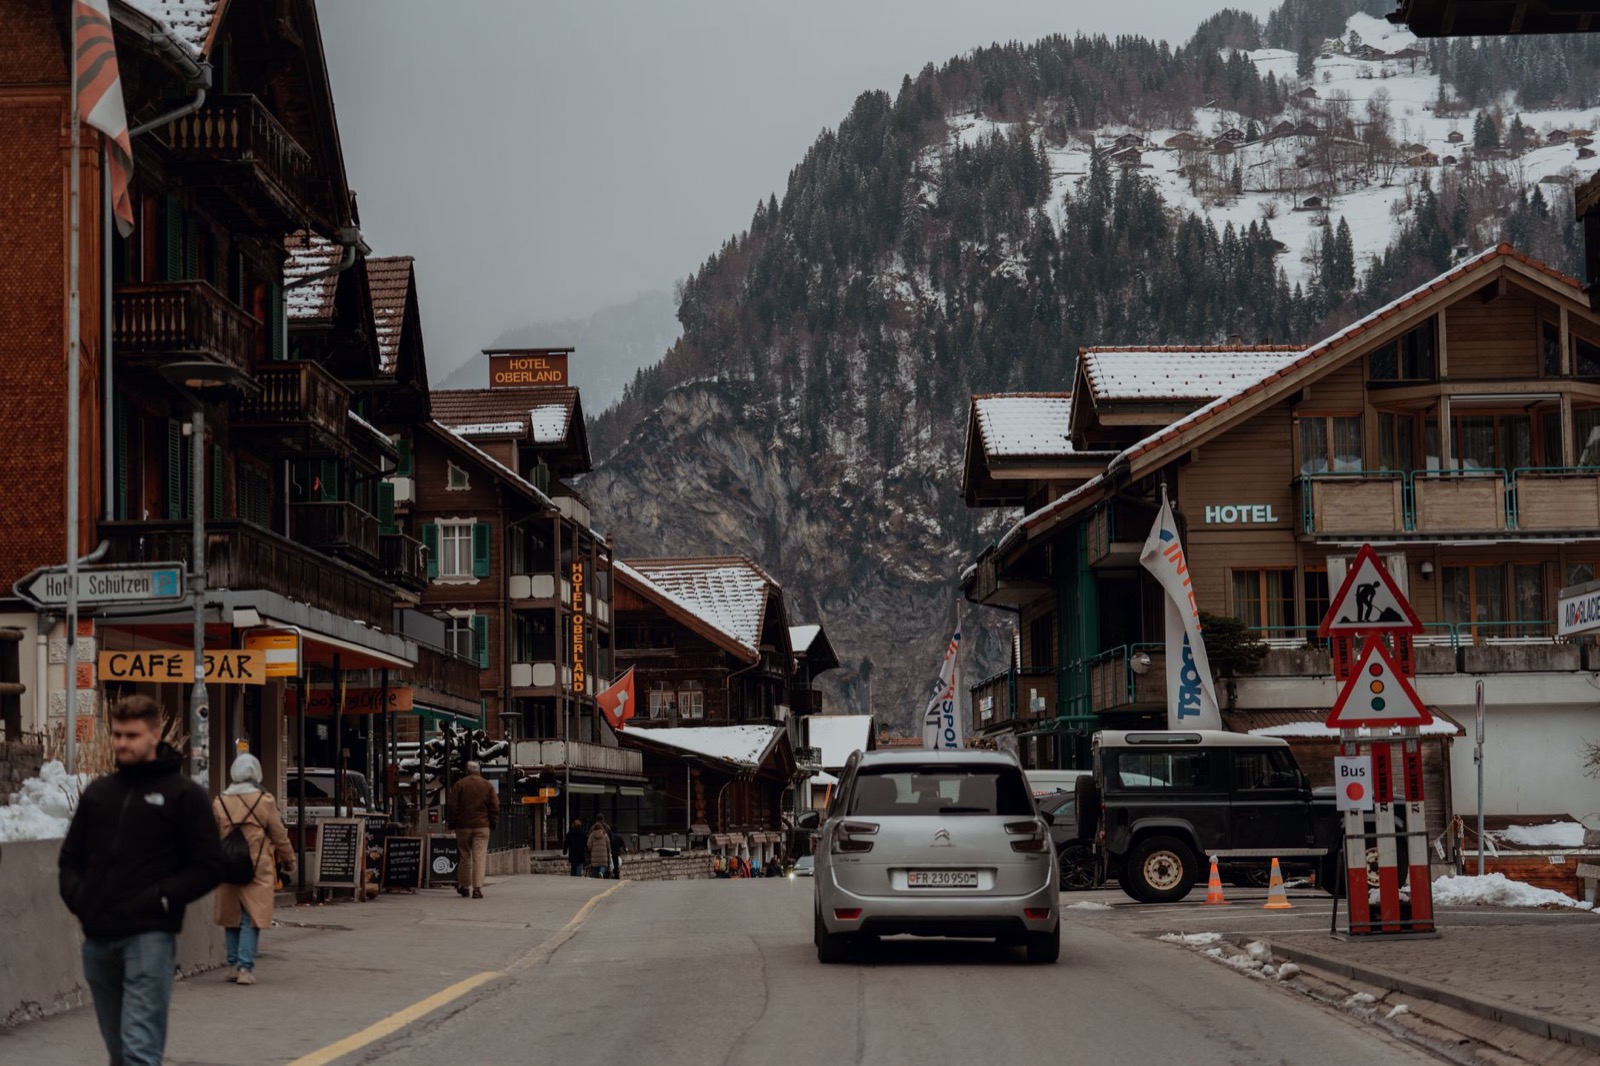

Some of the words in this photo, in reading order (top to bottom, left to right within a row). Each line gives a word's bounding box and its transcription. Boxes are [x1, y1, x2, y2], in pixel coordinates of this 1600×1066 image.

[510, 358, 550, 370] HOTEL
[495, 370, 562, 383] OBERLAND
[1205, 504, 1280, 524] HOTEL
[46, 575, 80, 597] Hotl
[89, 574, 150, 595] Schützen
[572, 562, 583, 611] HOTEL
[573, 614, 584, 692] OBERLAND
[109, 653, 184, 678] CAFÉ
[1341, 765, 1366, 777] Bus
